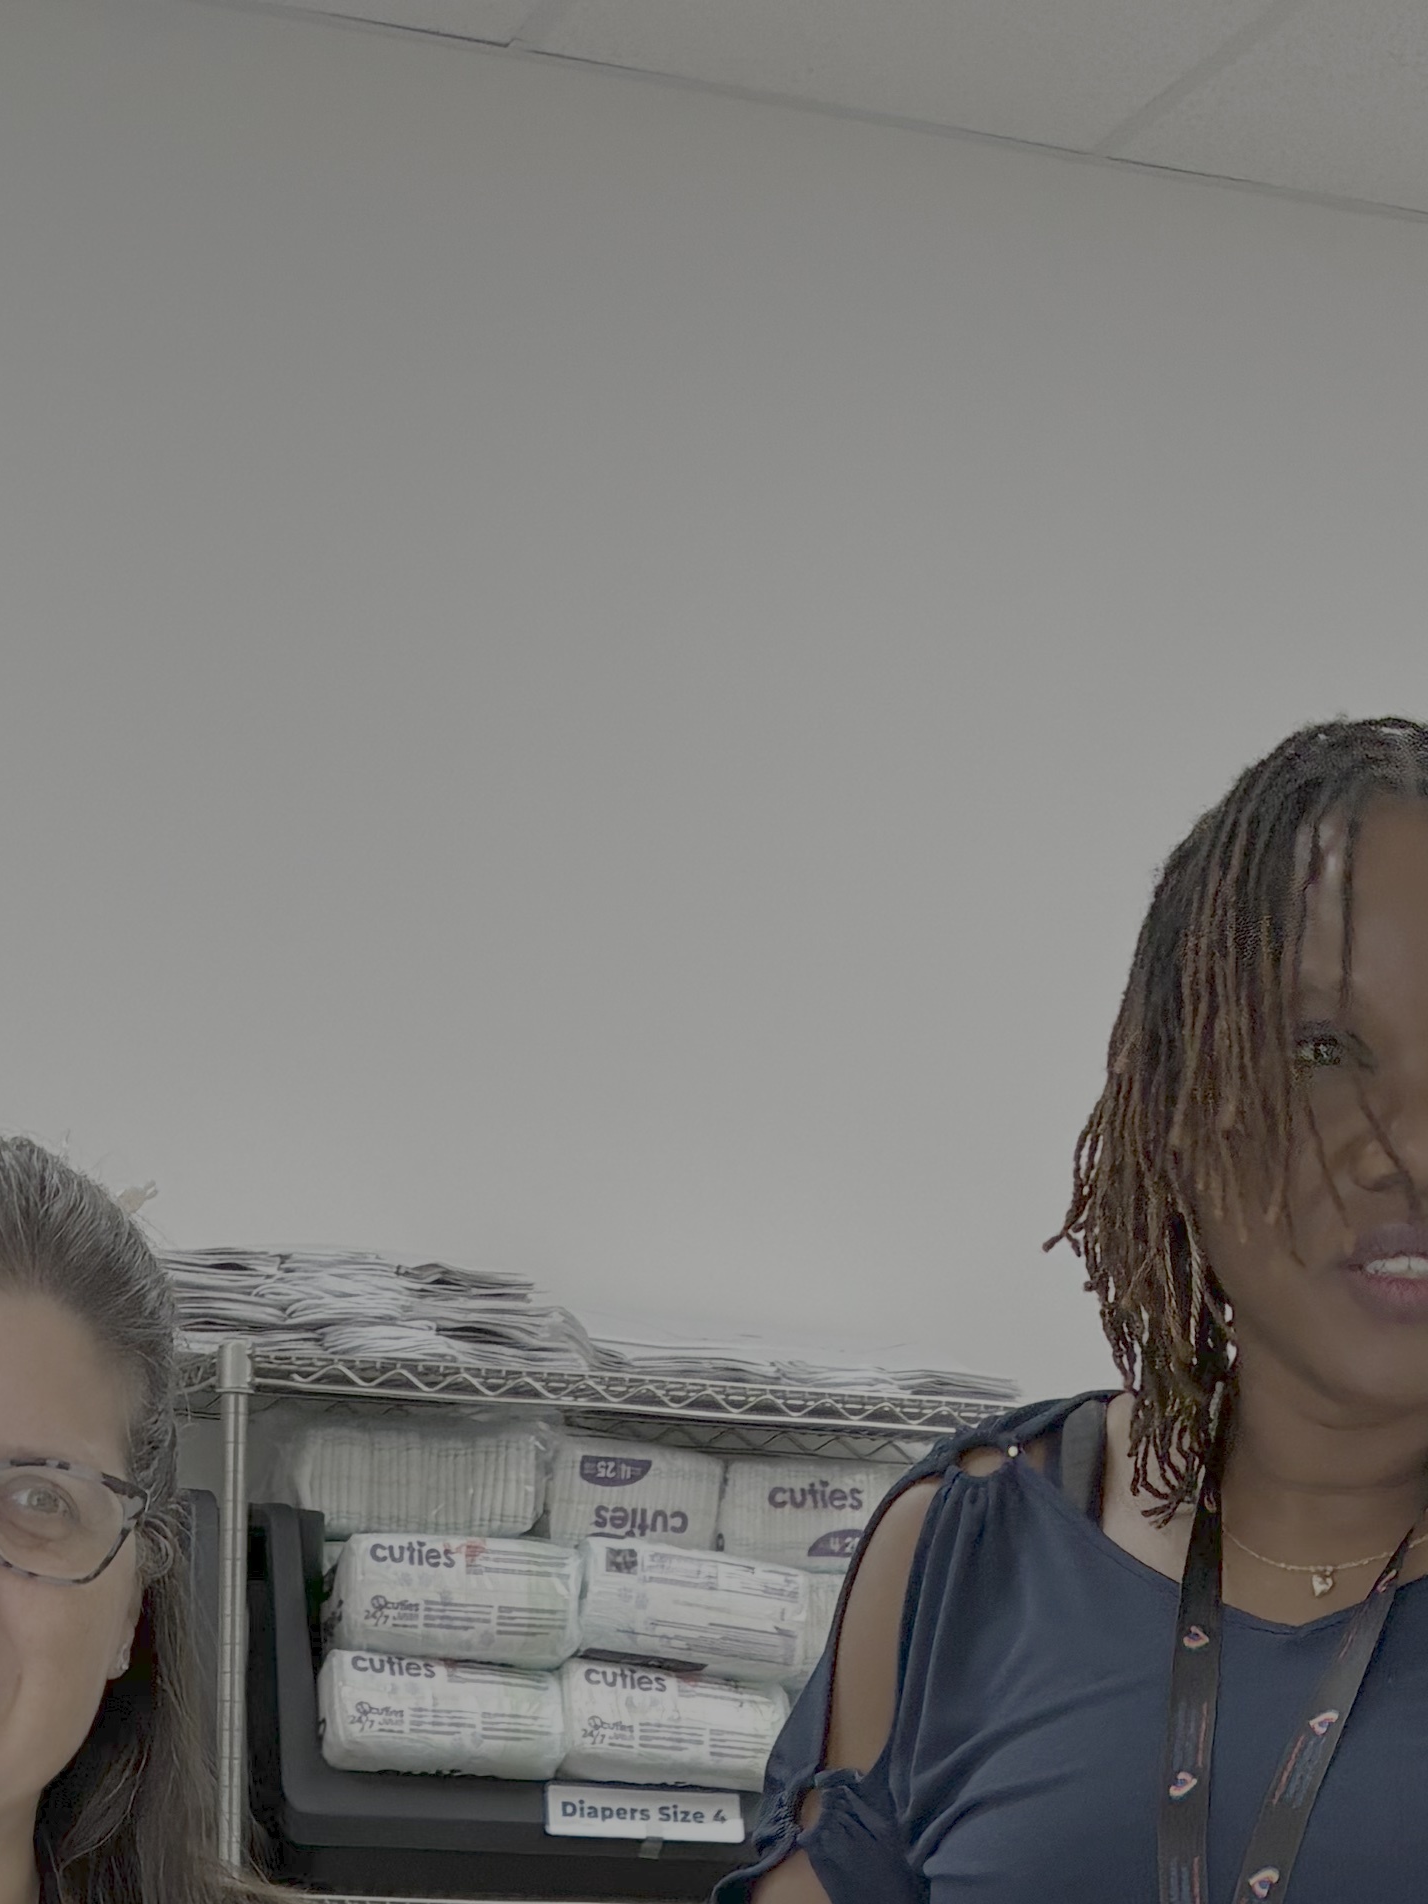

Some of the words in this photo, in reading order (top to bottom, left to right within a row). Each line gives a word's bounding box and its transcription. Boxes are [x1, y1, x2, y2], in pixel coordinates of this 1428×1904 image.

[597, 1461, 616, 1479] 25
[768, 1480, 864, 1511] cuties
[594, 1503, 689, 1537] cuties
[370, 1540, 456, 1570] cuties
[351, 1653, 436, 1680] cuties
[584, 1665, 668, 1693] cuties
[560, 1800, 651, 1825] Diapers
[658, 1802, 705, 1824] Size
[712, 1805, 727, 1825] 4
